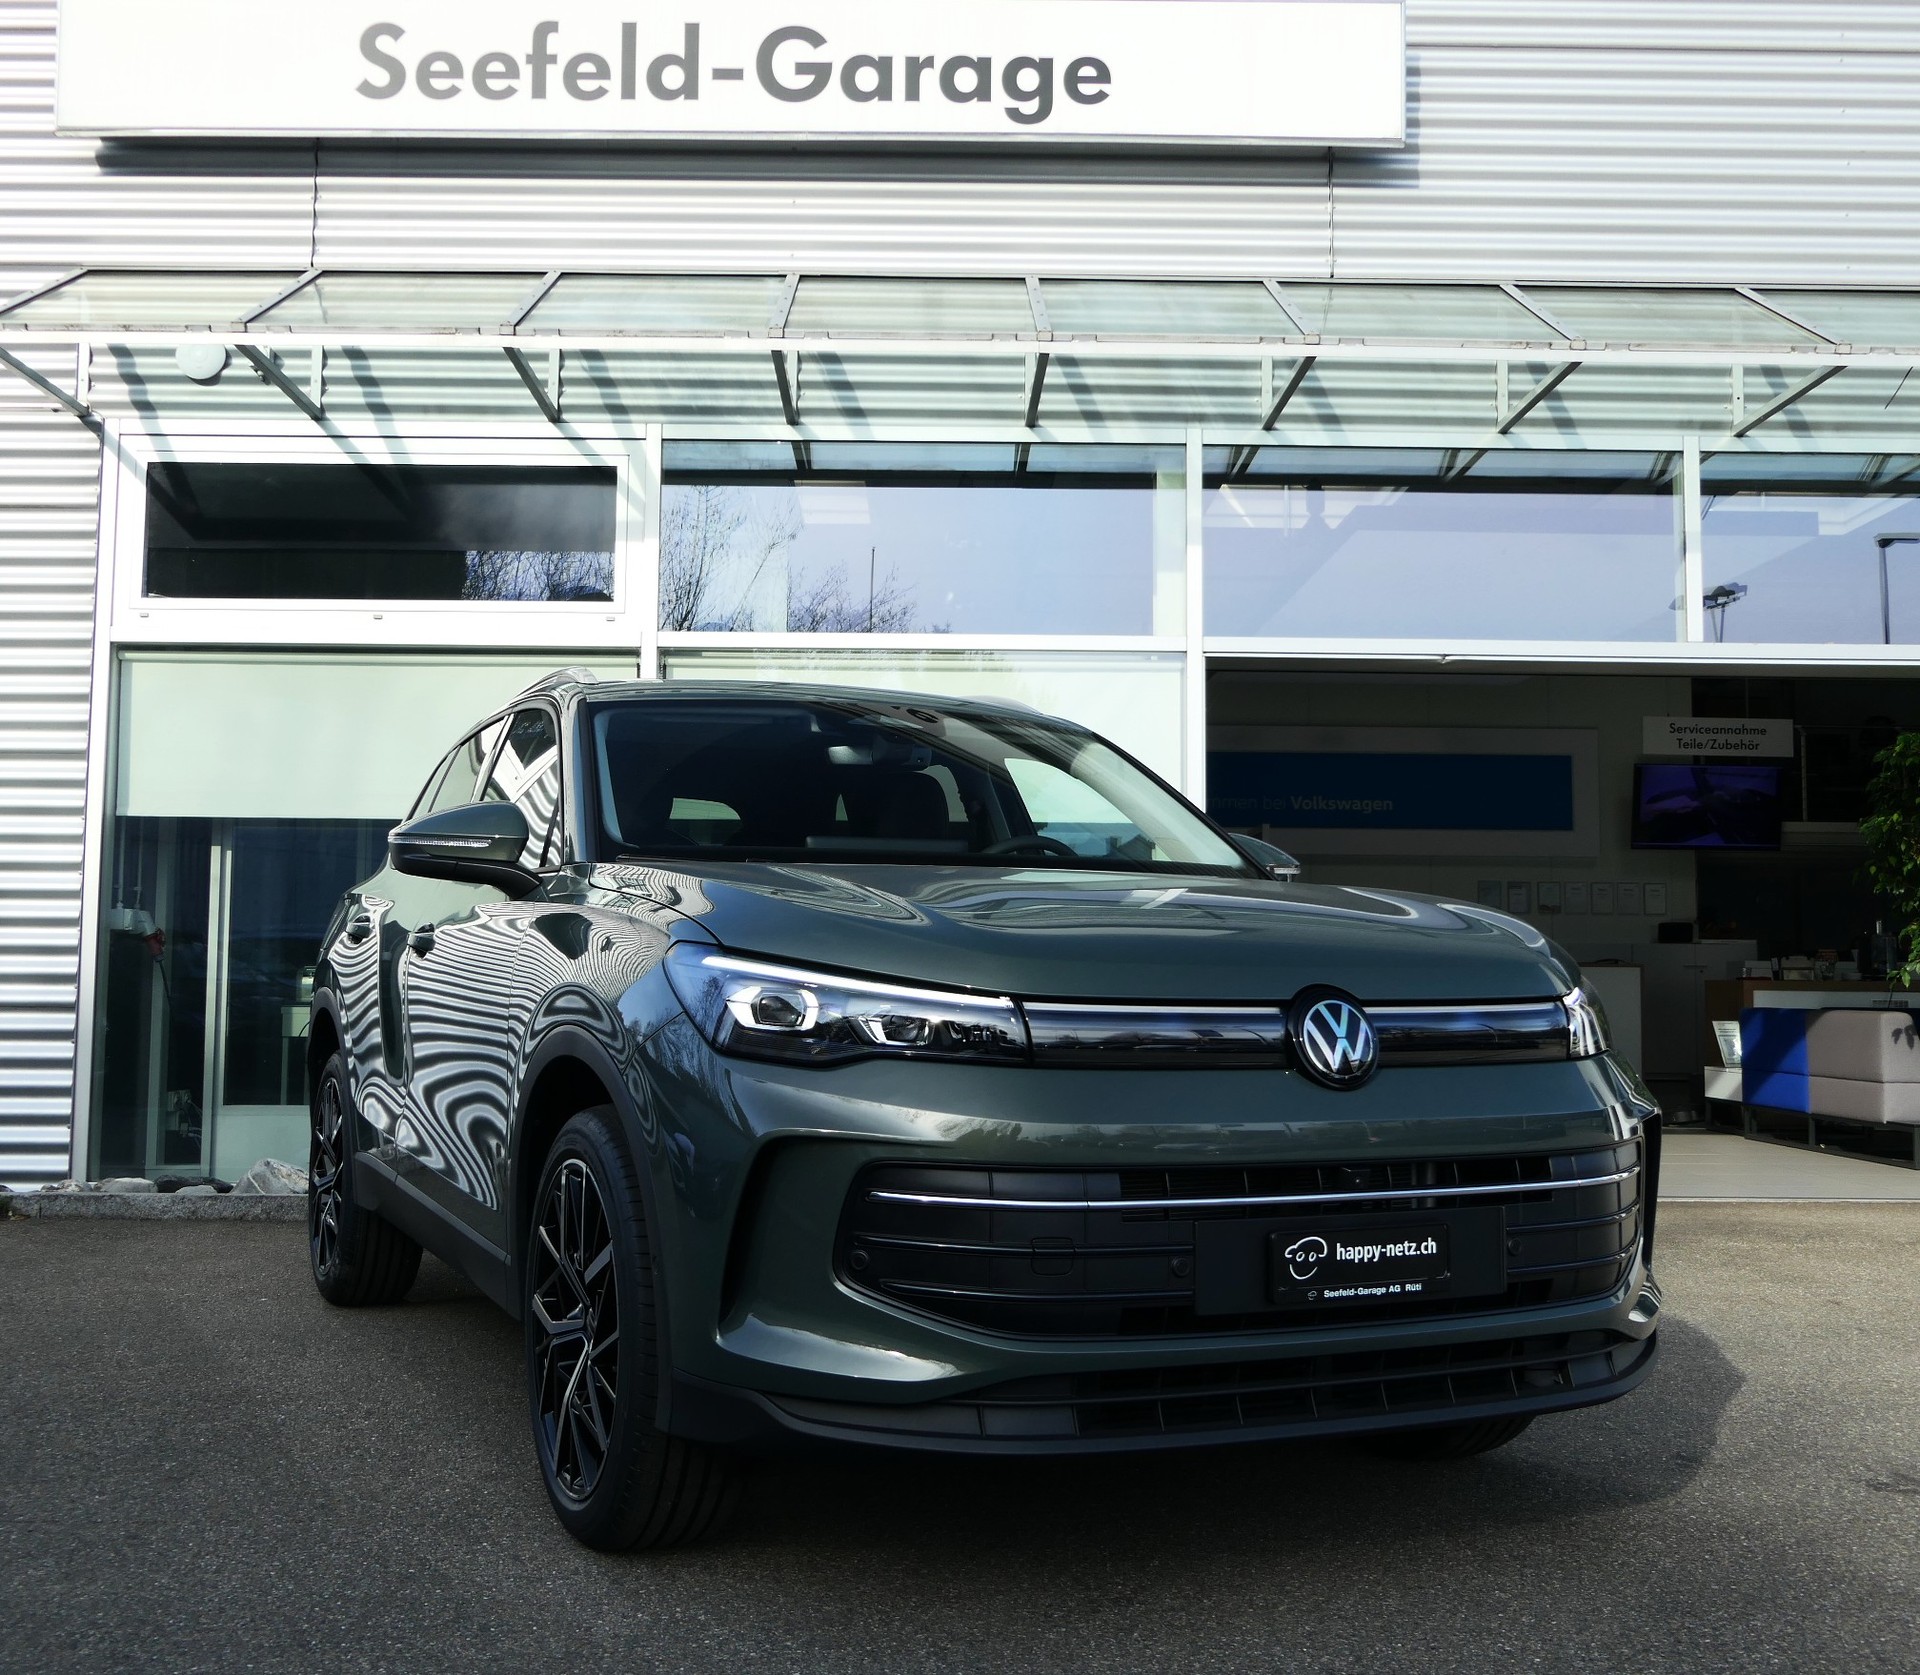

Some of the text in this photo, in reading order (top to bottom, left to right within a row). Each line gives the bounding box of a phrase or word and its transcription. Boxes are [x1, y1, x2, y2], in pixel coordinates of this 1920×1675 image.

[354, 20, 1112, 125] Seefeld-Garage
[1669, 722, 1767, 736] Serviceannahme
[1676, 738, 1760, 751] Teile/Zubehör
[1291, 795, 1393, 813] Volkswagen
[1336, 1237, 1437, 1263] happy-netz.ch
[1323, 1283, 1422, 1299] Seefeld-Garage AG Rüti
